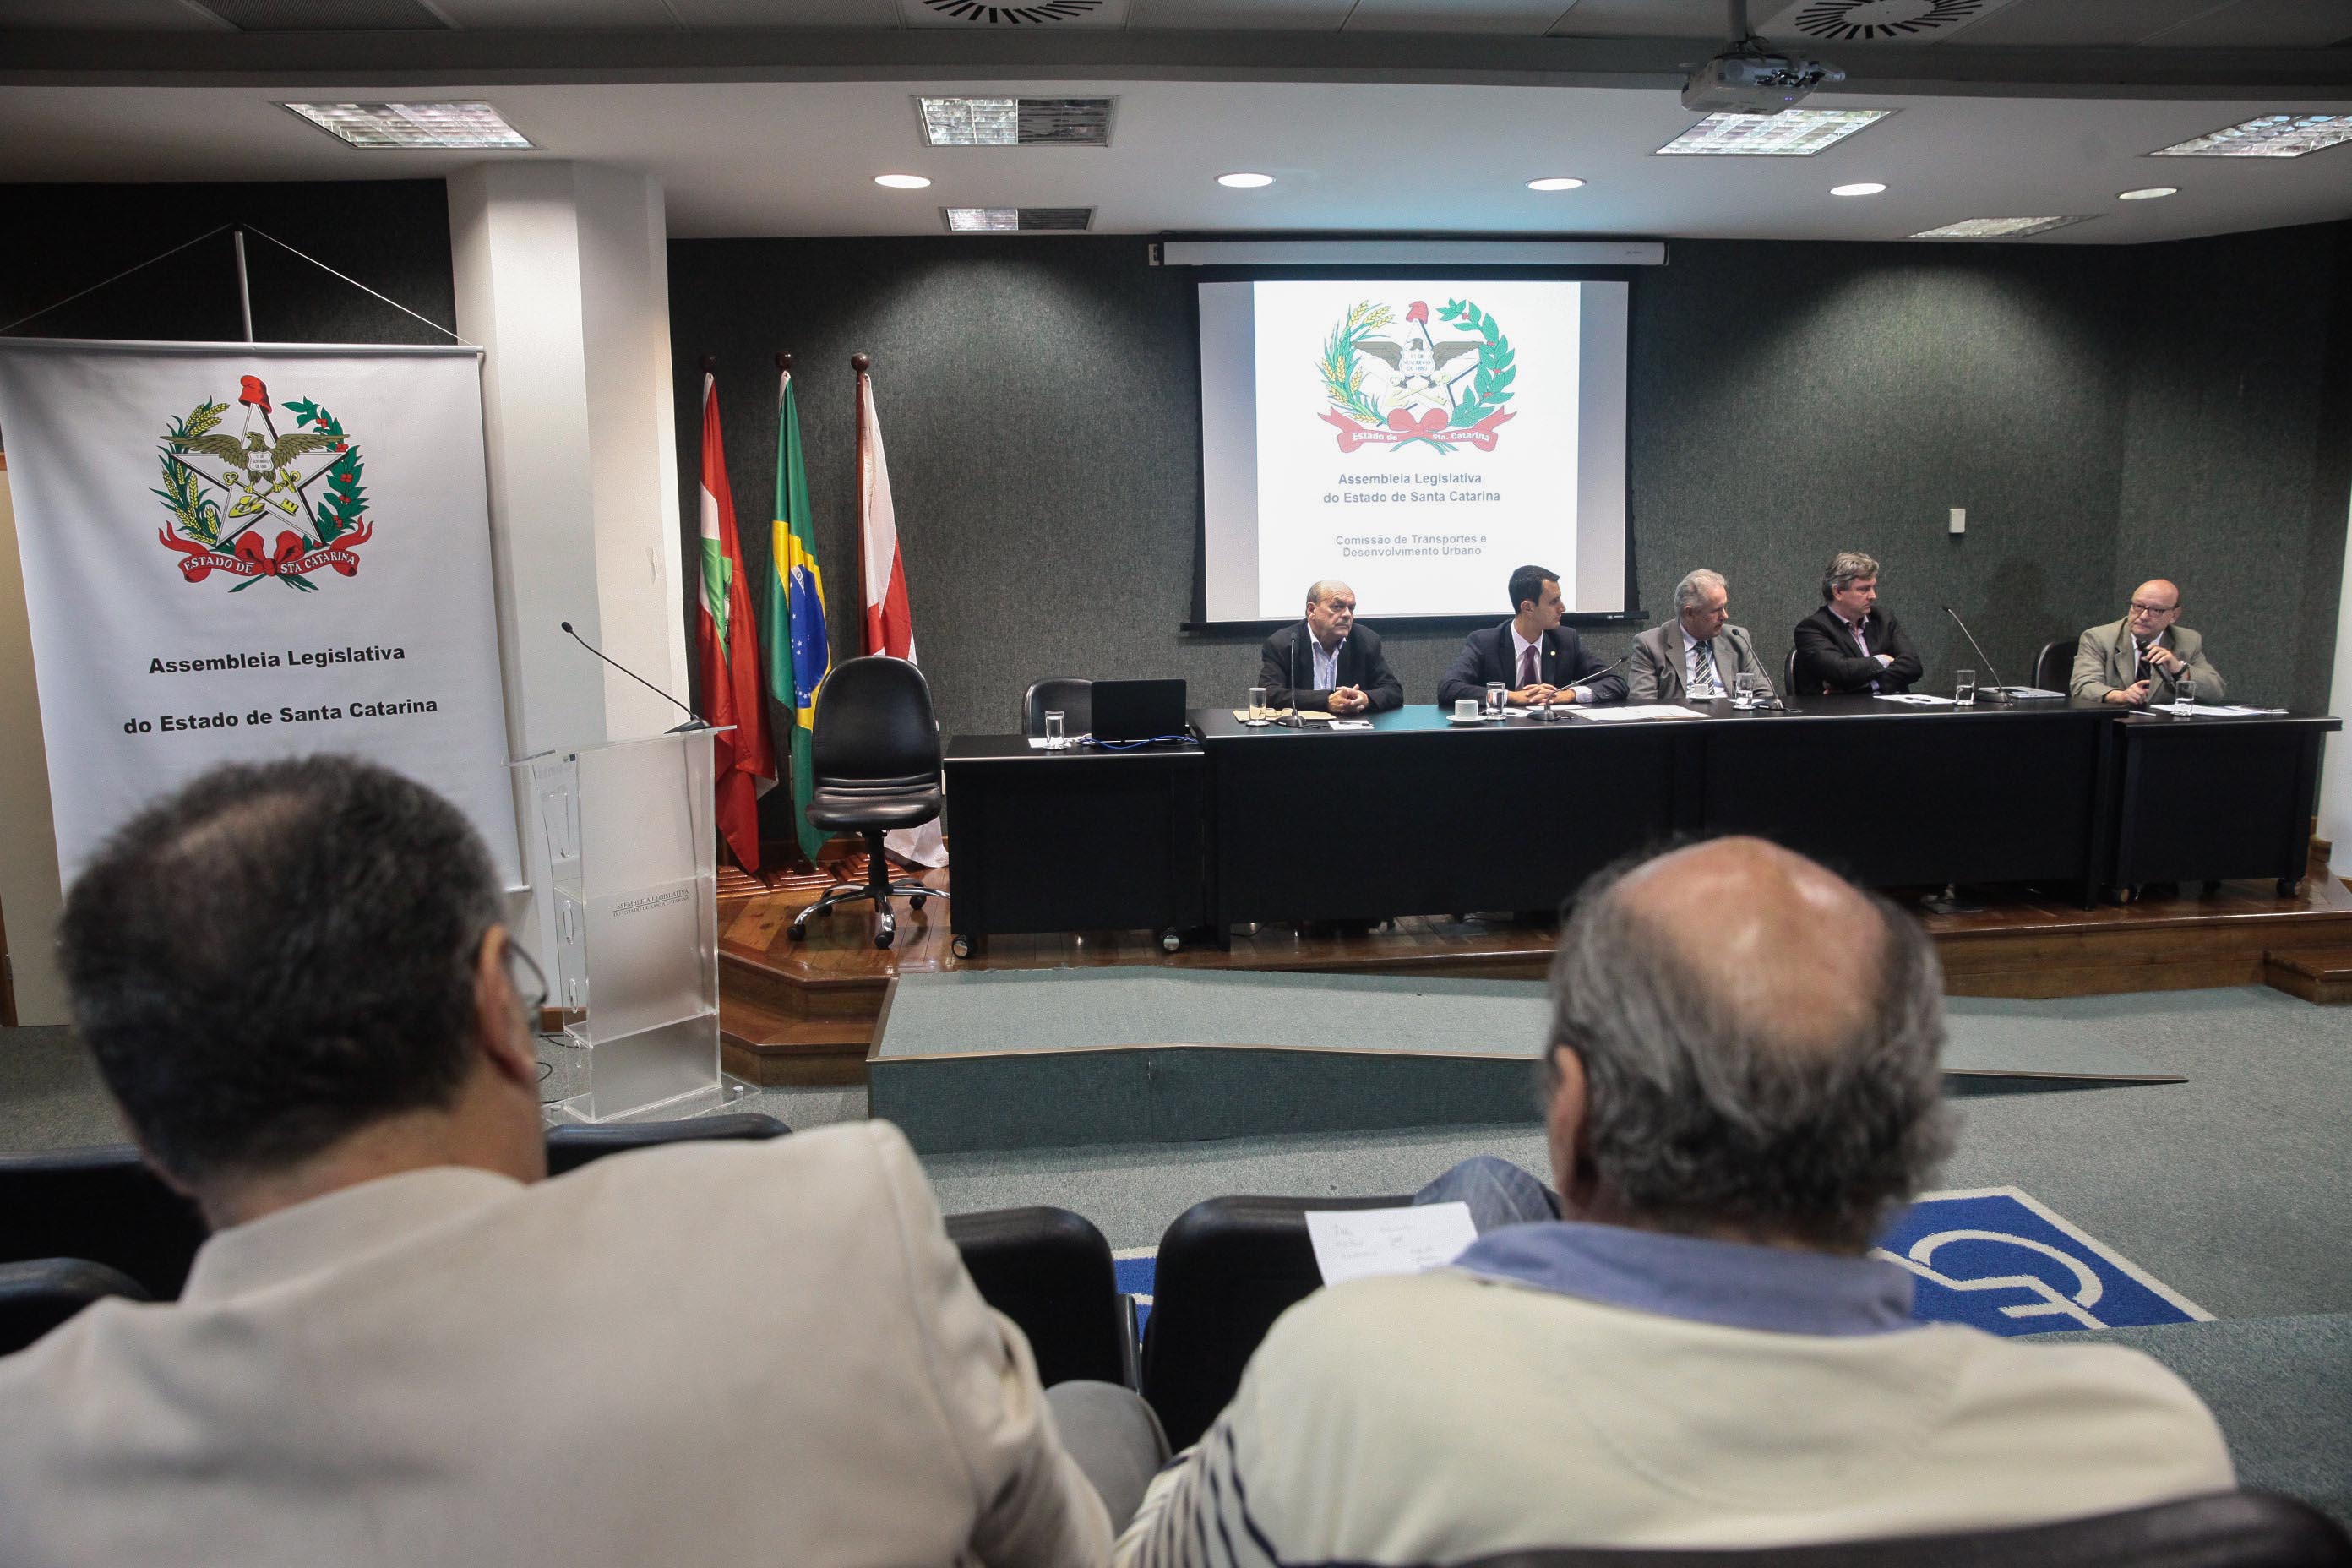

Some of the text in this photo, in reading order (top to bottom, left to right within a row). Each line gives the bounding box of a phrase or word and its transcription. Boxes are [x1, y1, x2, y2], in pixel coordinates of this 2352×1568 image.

[1353, 432, 1385, 441] Estado
[1451, 432, 1490, 442] Catarina
[1337, 472, 1482, 486] Assembleia Legislativa
[1323, 490, 1500, 503] do Estado de Santa Catarina
[1336, 534, 1487, 546] Comissão de Transportes e
[1342, 546, 1482, 557] Desenvolvimento Urbano
[183, 550, 355, 574] ESTADO DE STA. CATARINA
[149, 645, 406, 674] Assembleia Legislativa
[123, 699, 438, 735] do Estado de Santa Catarina
[651, 889, 689, 901] LEGISLATIVA
